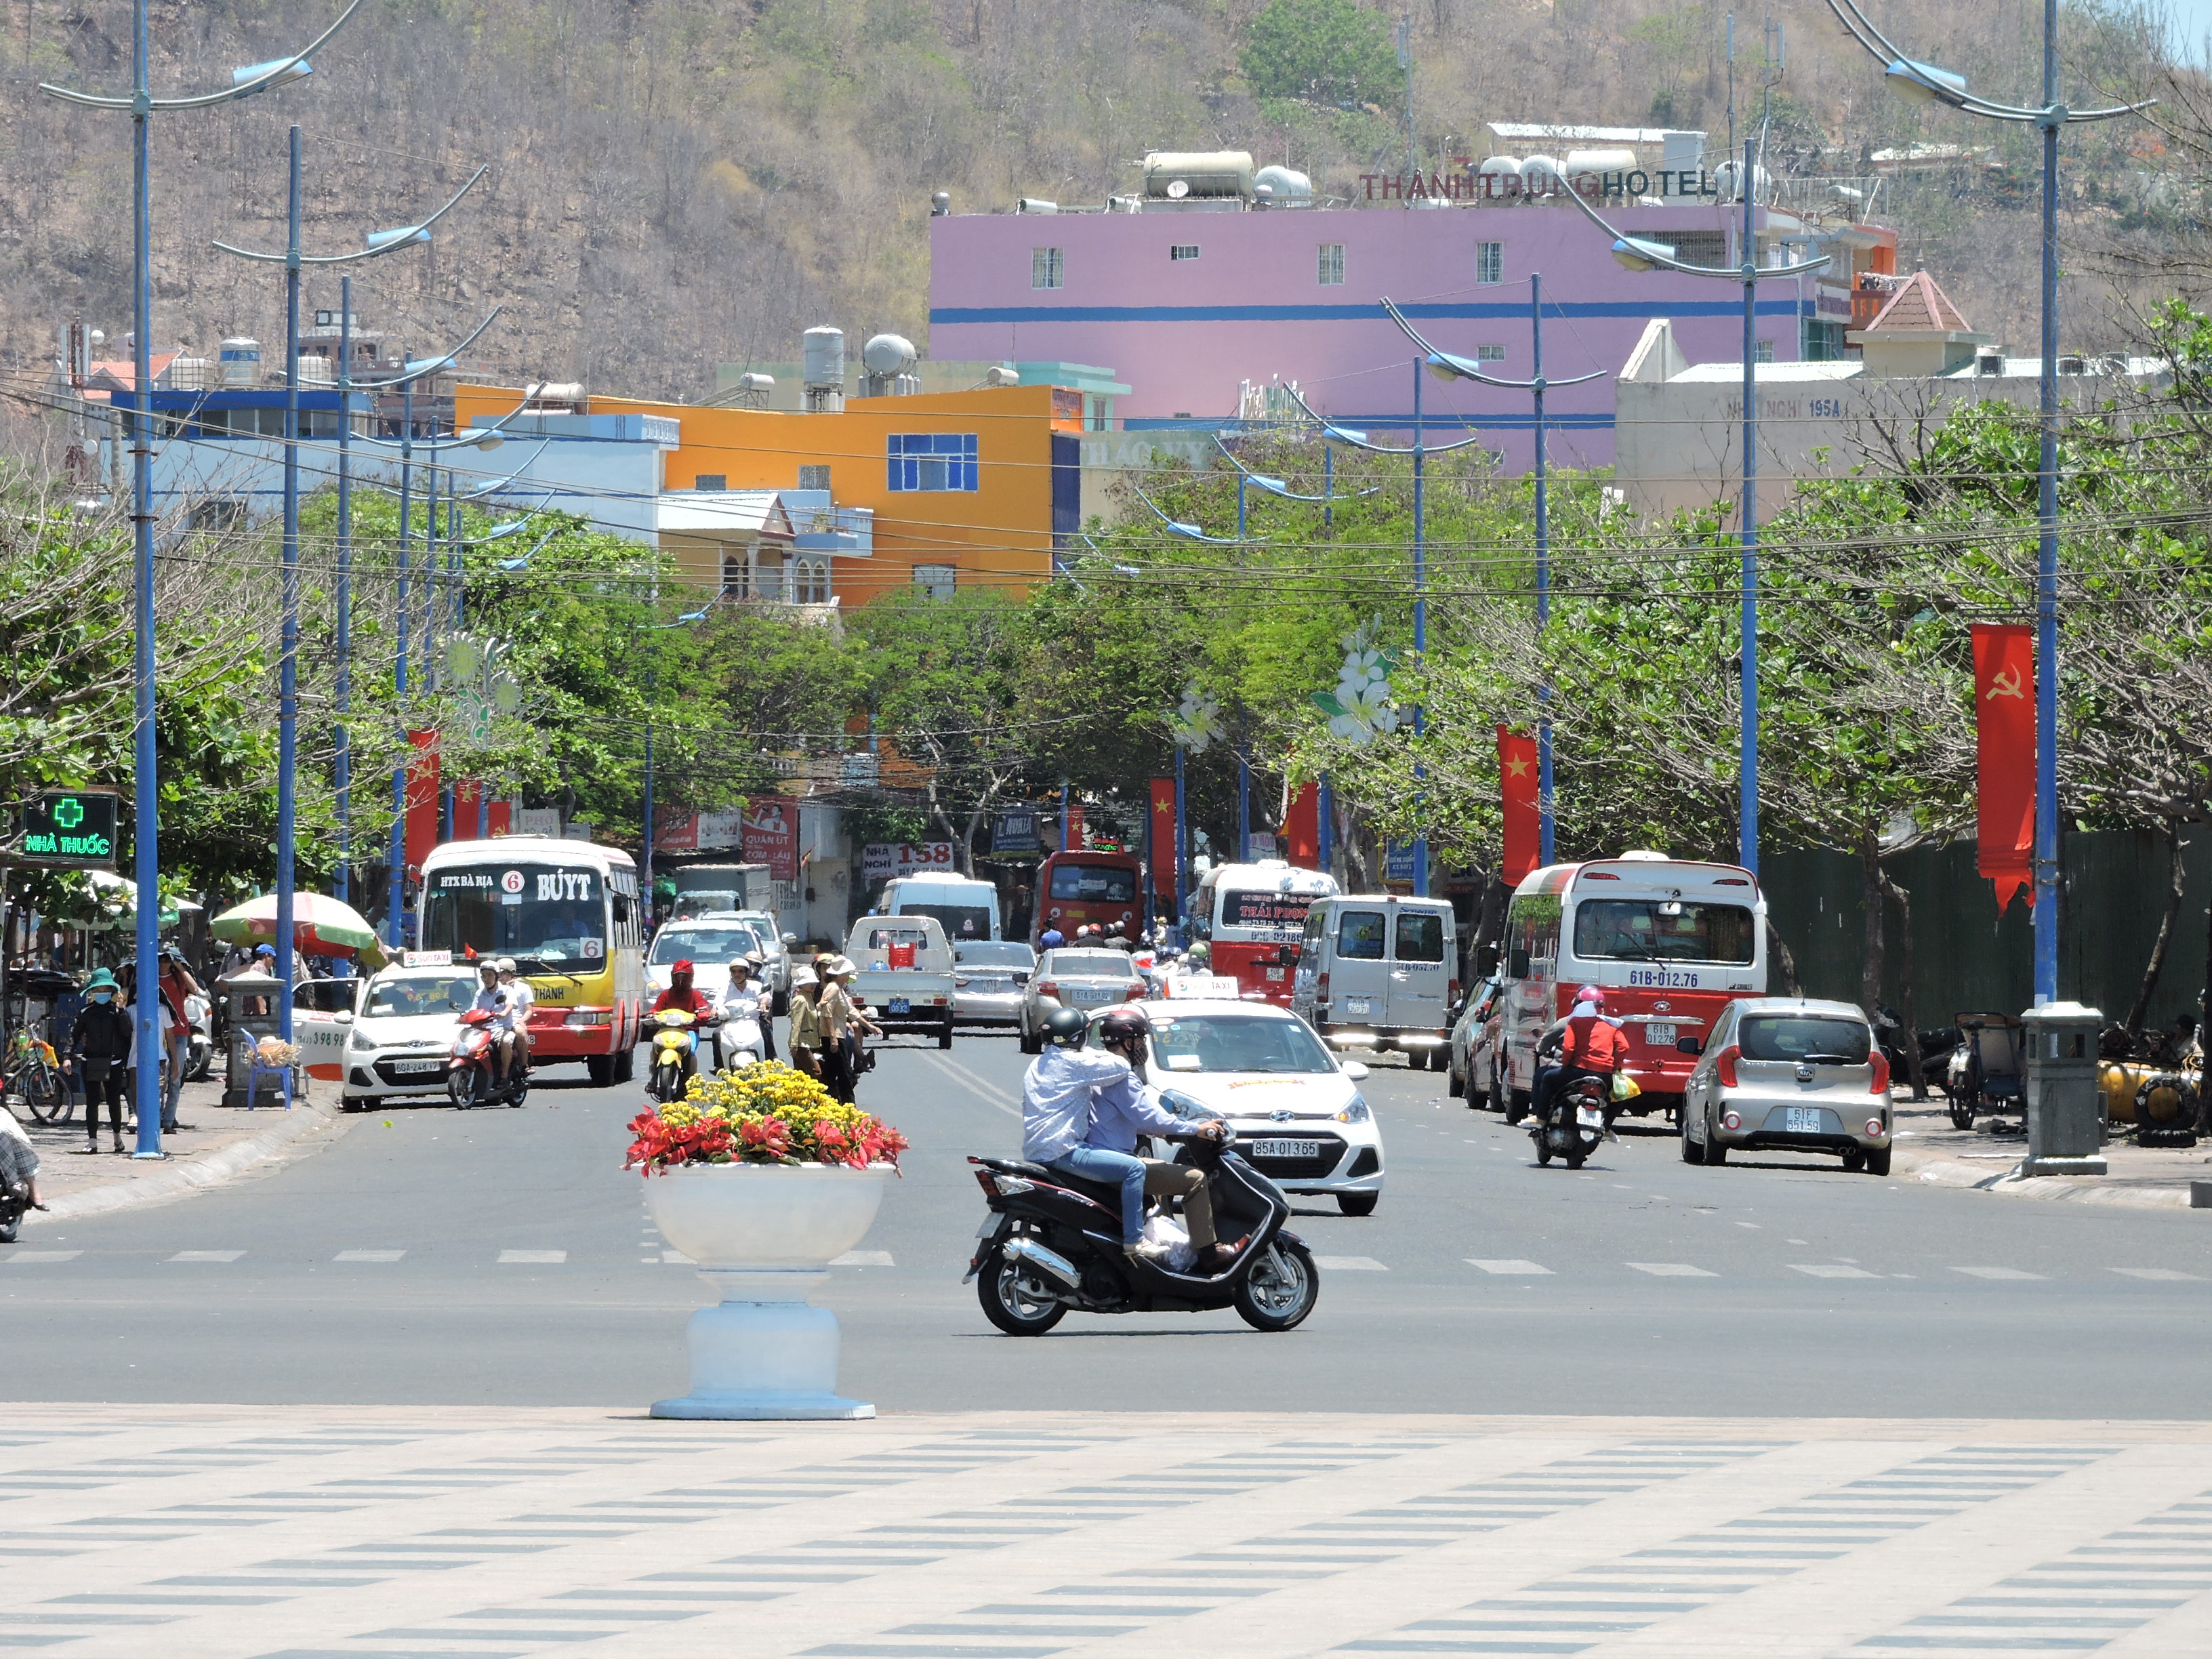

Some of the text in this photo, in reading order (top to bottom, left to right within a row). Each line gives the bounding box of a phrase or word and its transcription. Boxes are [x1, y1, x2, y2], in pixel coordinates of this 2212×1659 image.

[1809, 398, 1840, 417] 195A
[26, 832, 109, 854] NHÀ THUỐC
[898, 844, 951, 864] 158
[441, 876, 459, 887] HTX
[461, 873, 474, 886] BÀ
[507, 874, 519, 890] 6
[1274, 906, 1309, 919] PHON
[583, 941, 598, 959] 6
[434, 954, 449, 962] TAXI
[1212, 981, 1230, 989] TAXI
[1630, 970, 1698, 987] 61B-012.76
[1654, 1024, 1668, 1034] 61B
[1795, 1109, 1812, 1119] 51F
